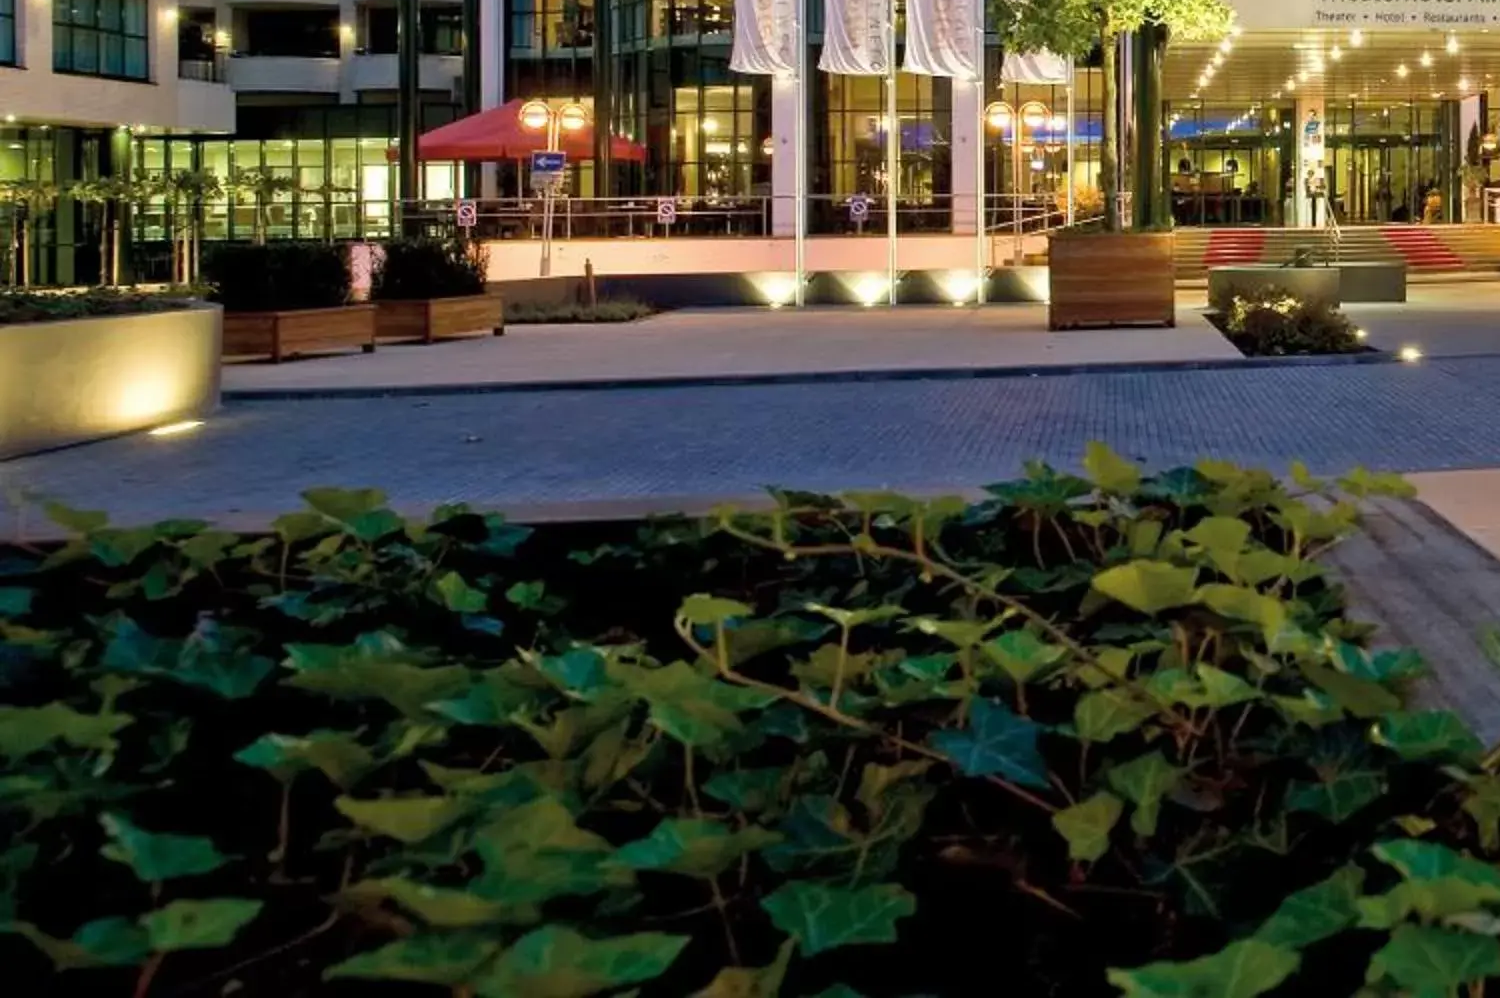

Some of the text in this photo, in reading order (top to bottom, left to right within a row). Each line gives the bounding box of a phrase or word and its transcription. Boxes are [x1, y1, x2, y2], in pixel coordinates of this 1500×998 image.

[1315, 10, 1357, 23] Theater
[1375, 12, 1405, 24] Hotel
[1423, 11, 1486, 25] Restaurants
